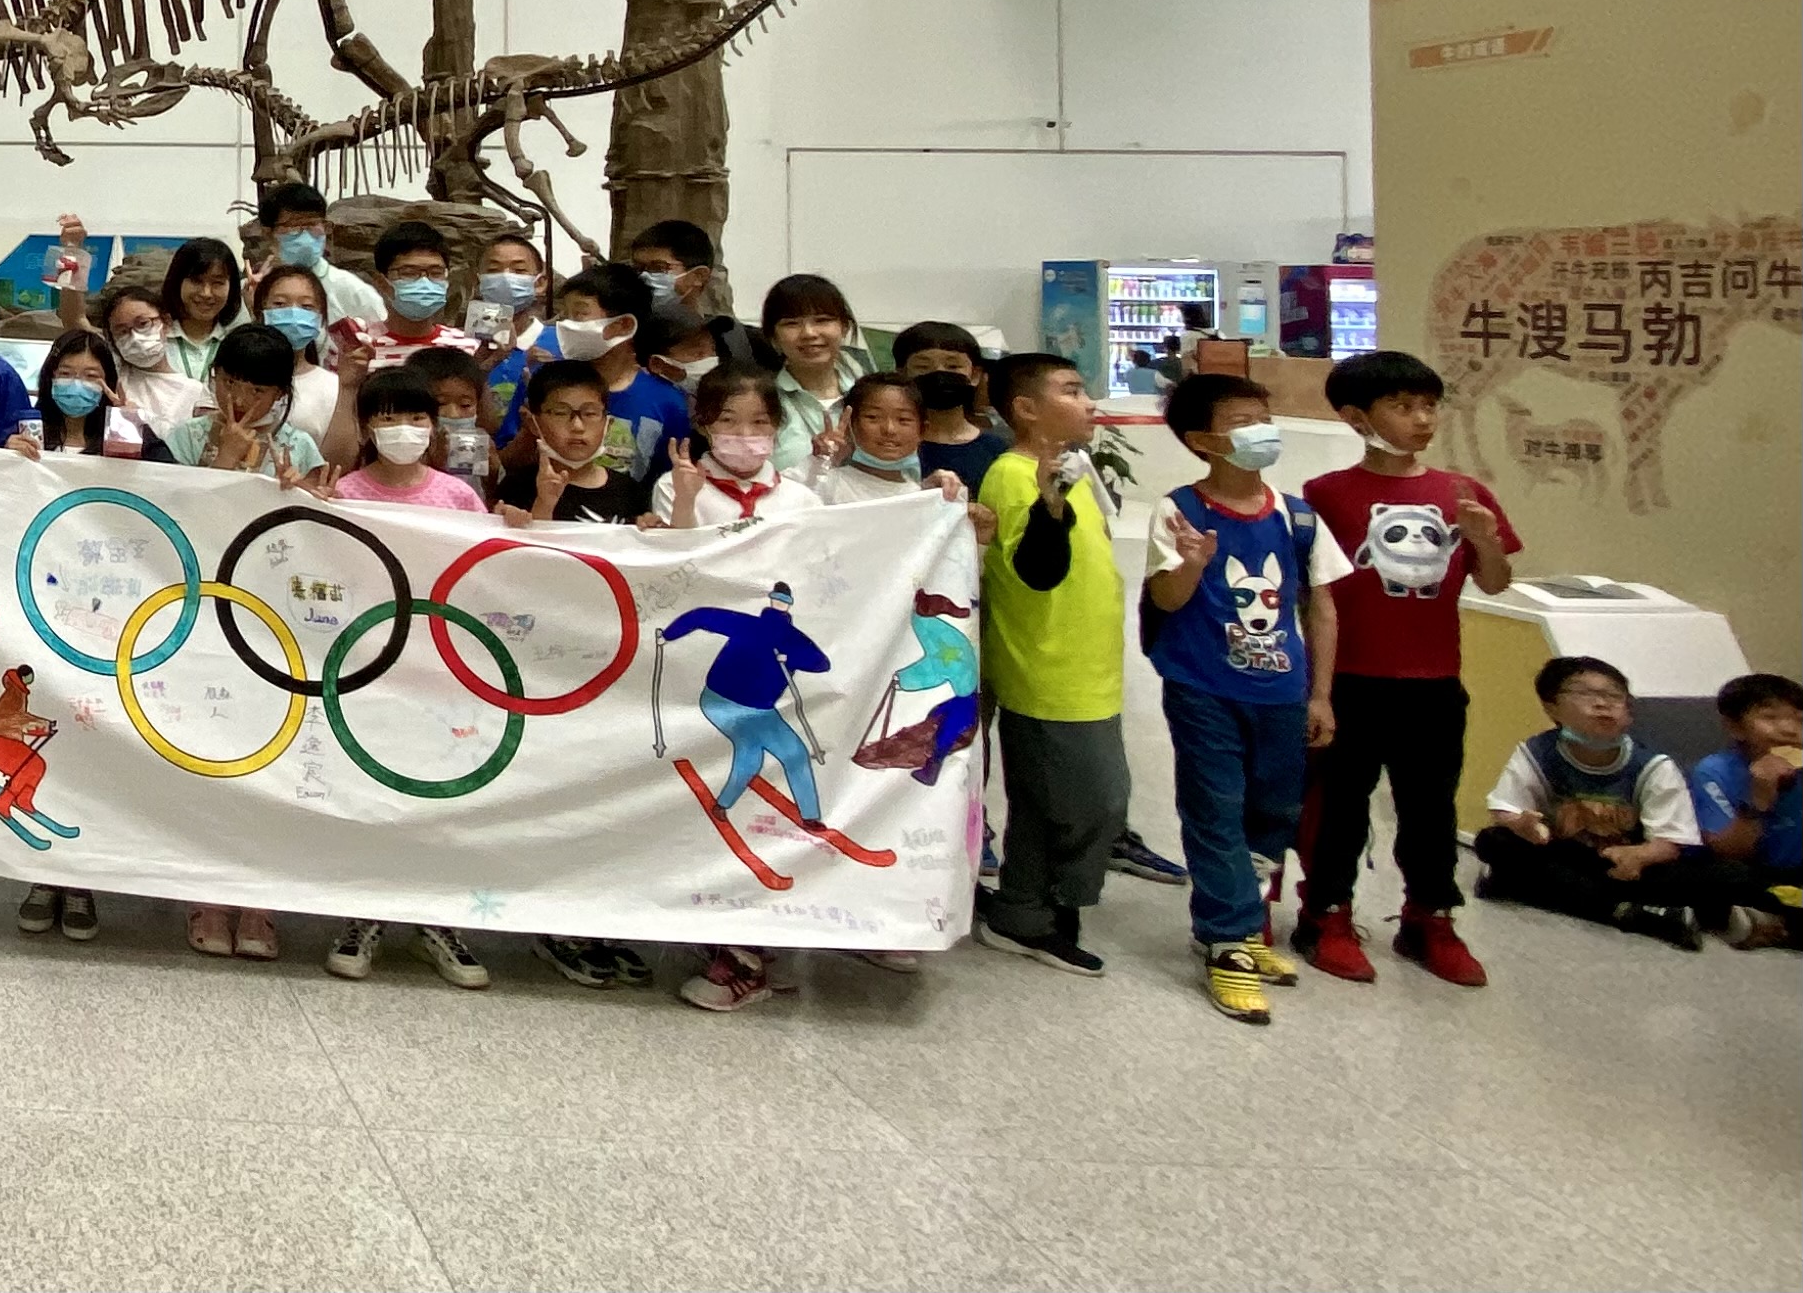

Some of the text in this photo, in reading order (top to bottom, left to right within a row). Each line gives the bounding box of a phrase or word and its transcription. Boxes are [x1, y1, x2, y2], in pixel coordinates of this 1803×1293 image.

[1637, 257, 1801, 300] 丙吉问牛
[1460, 298, 1702, 367] 牛溲马勃
